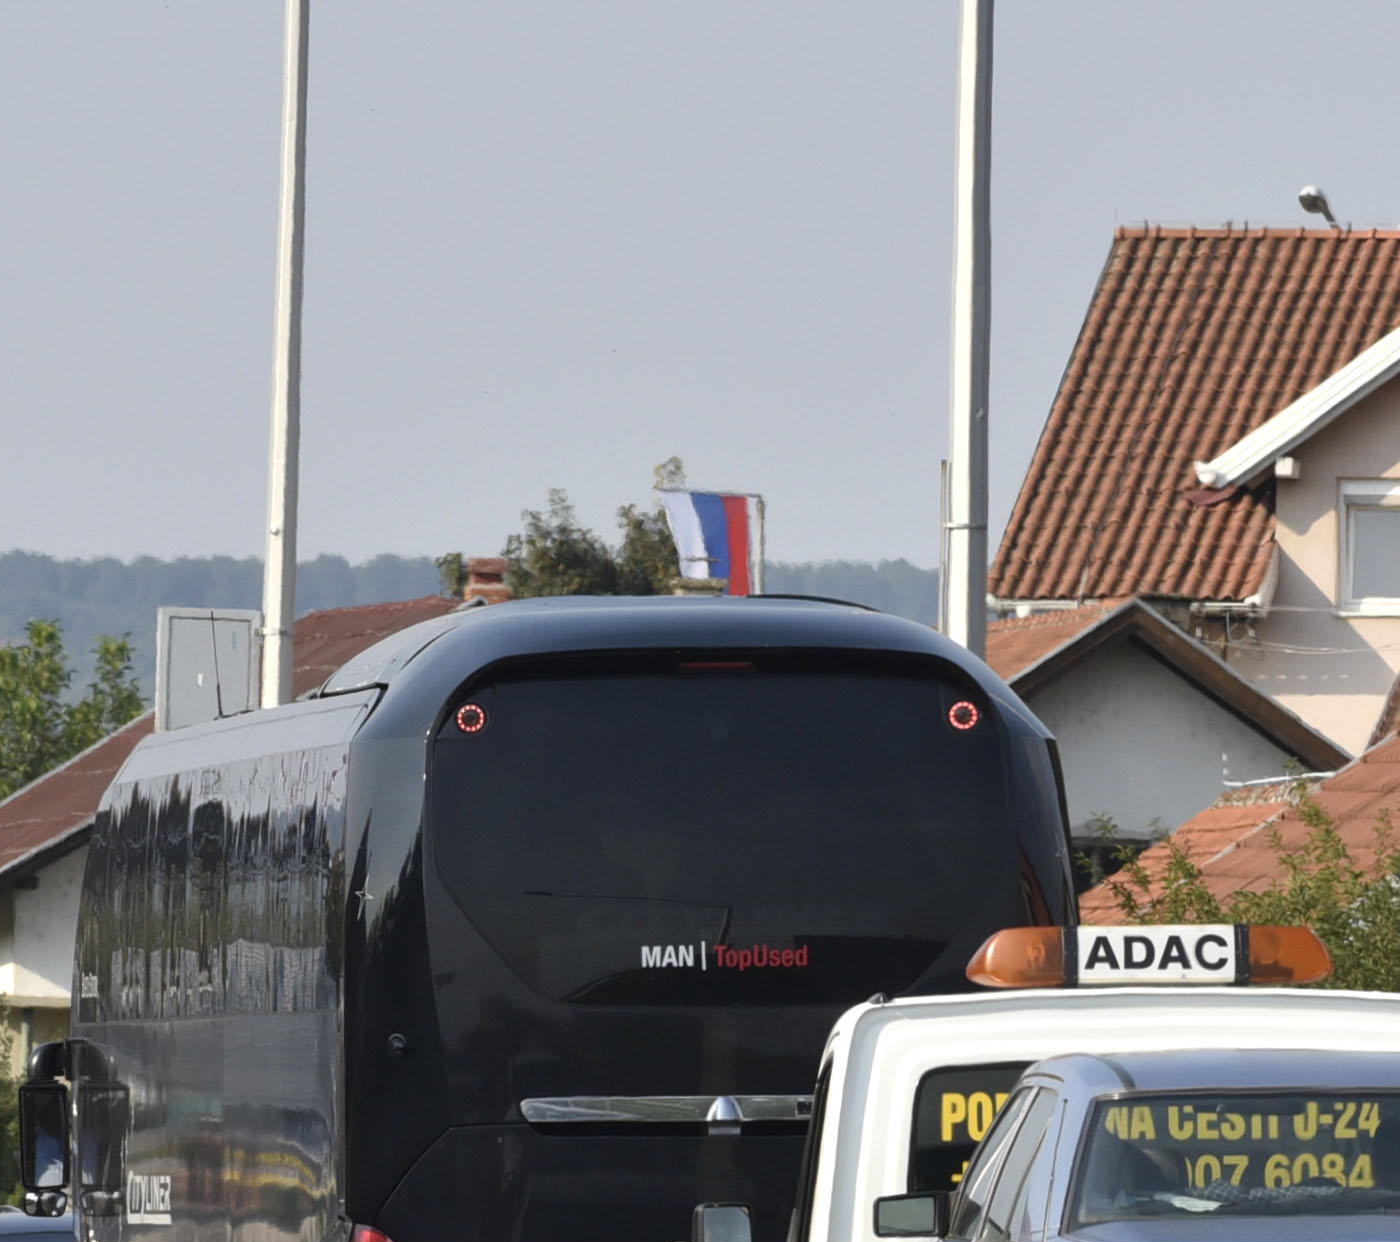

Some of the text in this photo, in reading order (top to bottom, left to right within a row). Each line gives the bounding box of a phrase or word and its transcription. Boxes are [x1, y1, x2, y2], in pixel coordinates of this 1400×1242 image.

[641, 944, 809, 971] MAN TopUsed
[1085, 933, 1230, 970] ADAC
[1105, 1105, 1156, 1140] NA
